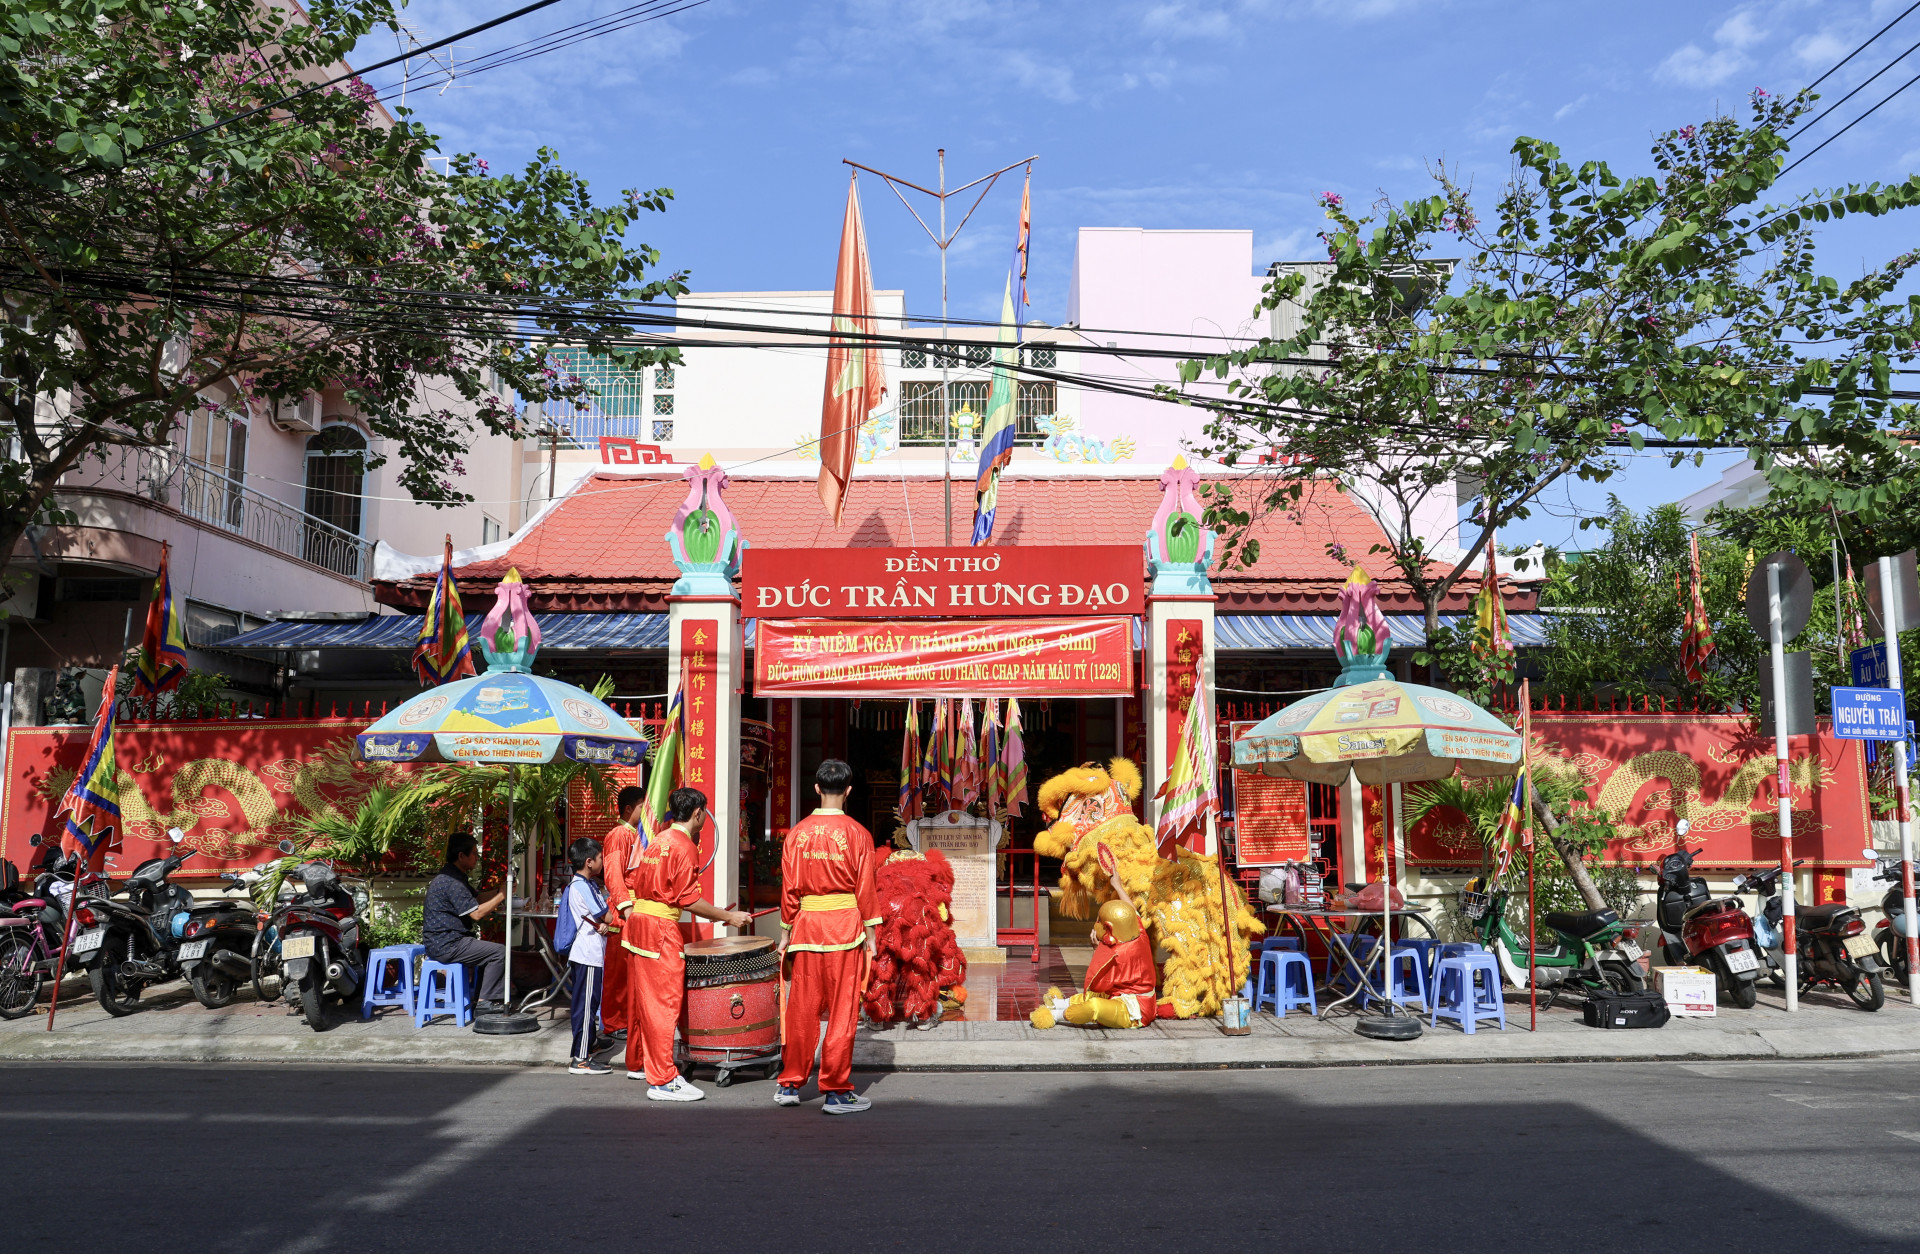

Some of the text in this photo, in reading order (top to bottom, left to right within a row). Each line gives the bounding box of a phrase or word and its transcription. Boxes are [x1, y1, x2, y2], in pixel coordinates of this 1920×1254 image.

[885, 550, 1001, 572] ĐỀN THỜ
[756, 577, 1130, 611] ĐỨC TRẦN HƯNG ĐẠO
[792, 629, 815, 653] KỶ
[819, 631, 859, 657] NIỆM
[863, 630, 905, 653] NGÀY
[909, 630, 962, 653] THÁNH
[967, 629, 999, 652] ĐẢN
[1004, 633, 1044, 656] (Ngày
[767, 656, 1121, 684] ĐỨC HƯNG ĐẠO ĐẠI VƯƠNG MỒNG 10 THÁNG CHẠP NĂM MẬU TÝ (1228)
[1860, 659, 1887, 684] ÂU CƠ
[1855, 693, 1882, 702] ĐƯỜNG
[1838, 702, 1900, 726] NGUYỄN TRÃI
[365, 736, 401, 758] Sanest
[474, 736, 491, 745] SÀO
[492, 736, 521, 746] KHÁNH
[522, 737, 541, 746] HÒA
[576, 737, 615, 760] Sanest
[1338, 734, 1386, 753] Sanest
[453, 748, 470, 757] YẾN
[492, 749, 515, 757] THIÊN
[517, 749, 542, 758] NHIÊN
[1492, 750, 1512, 760] NHIÊN
[1733, 960, 1755, 971] 4308
